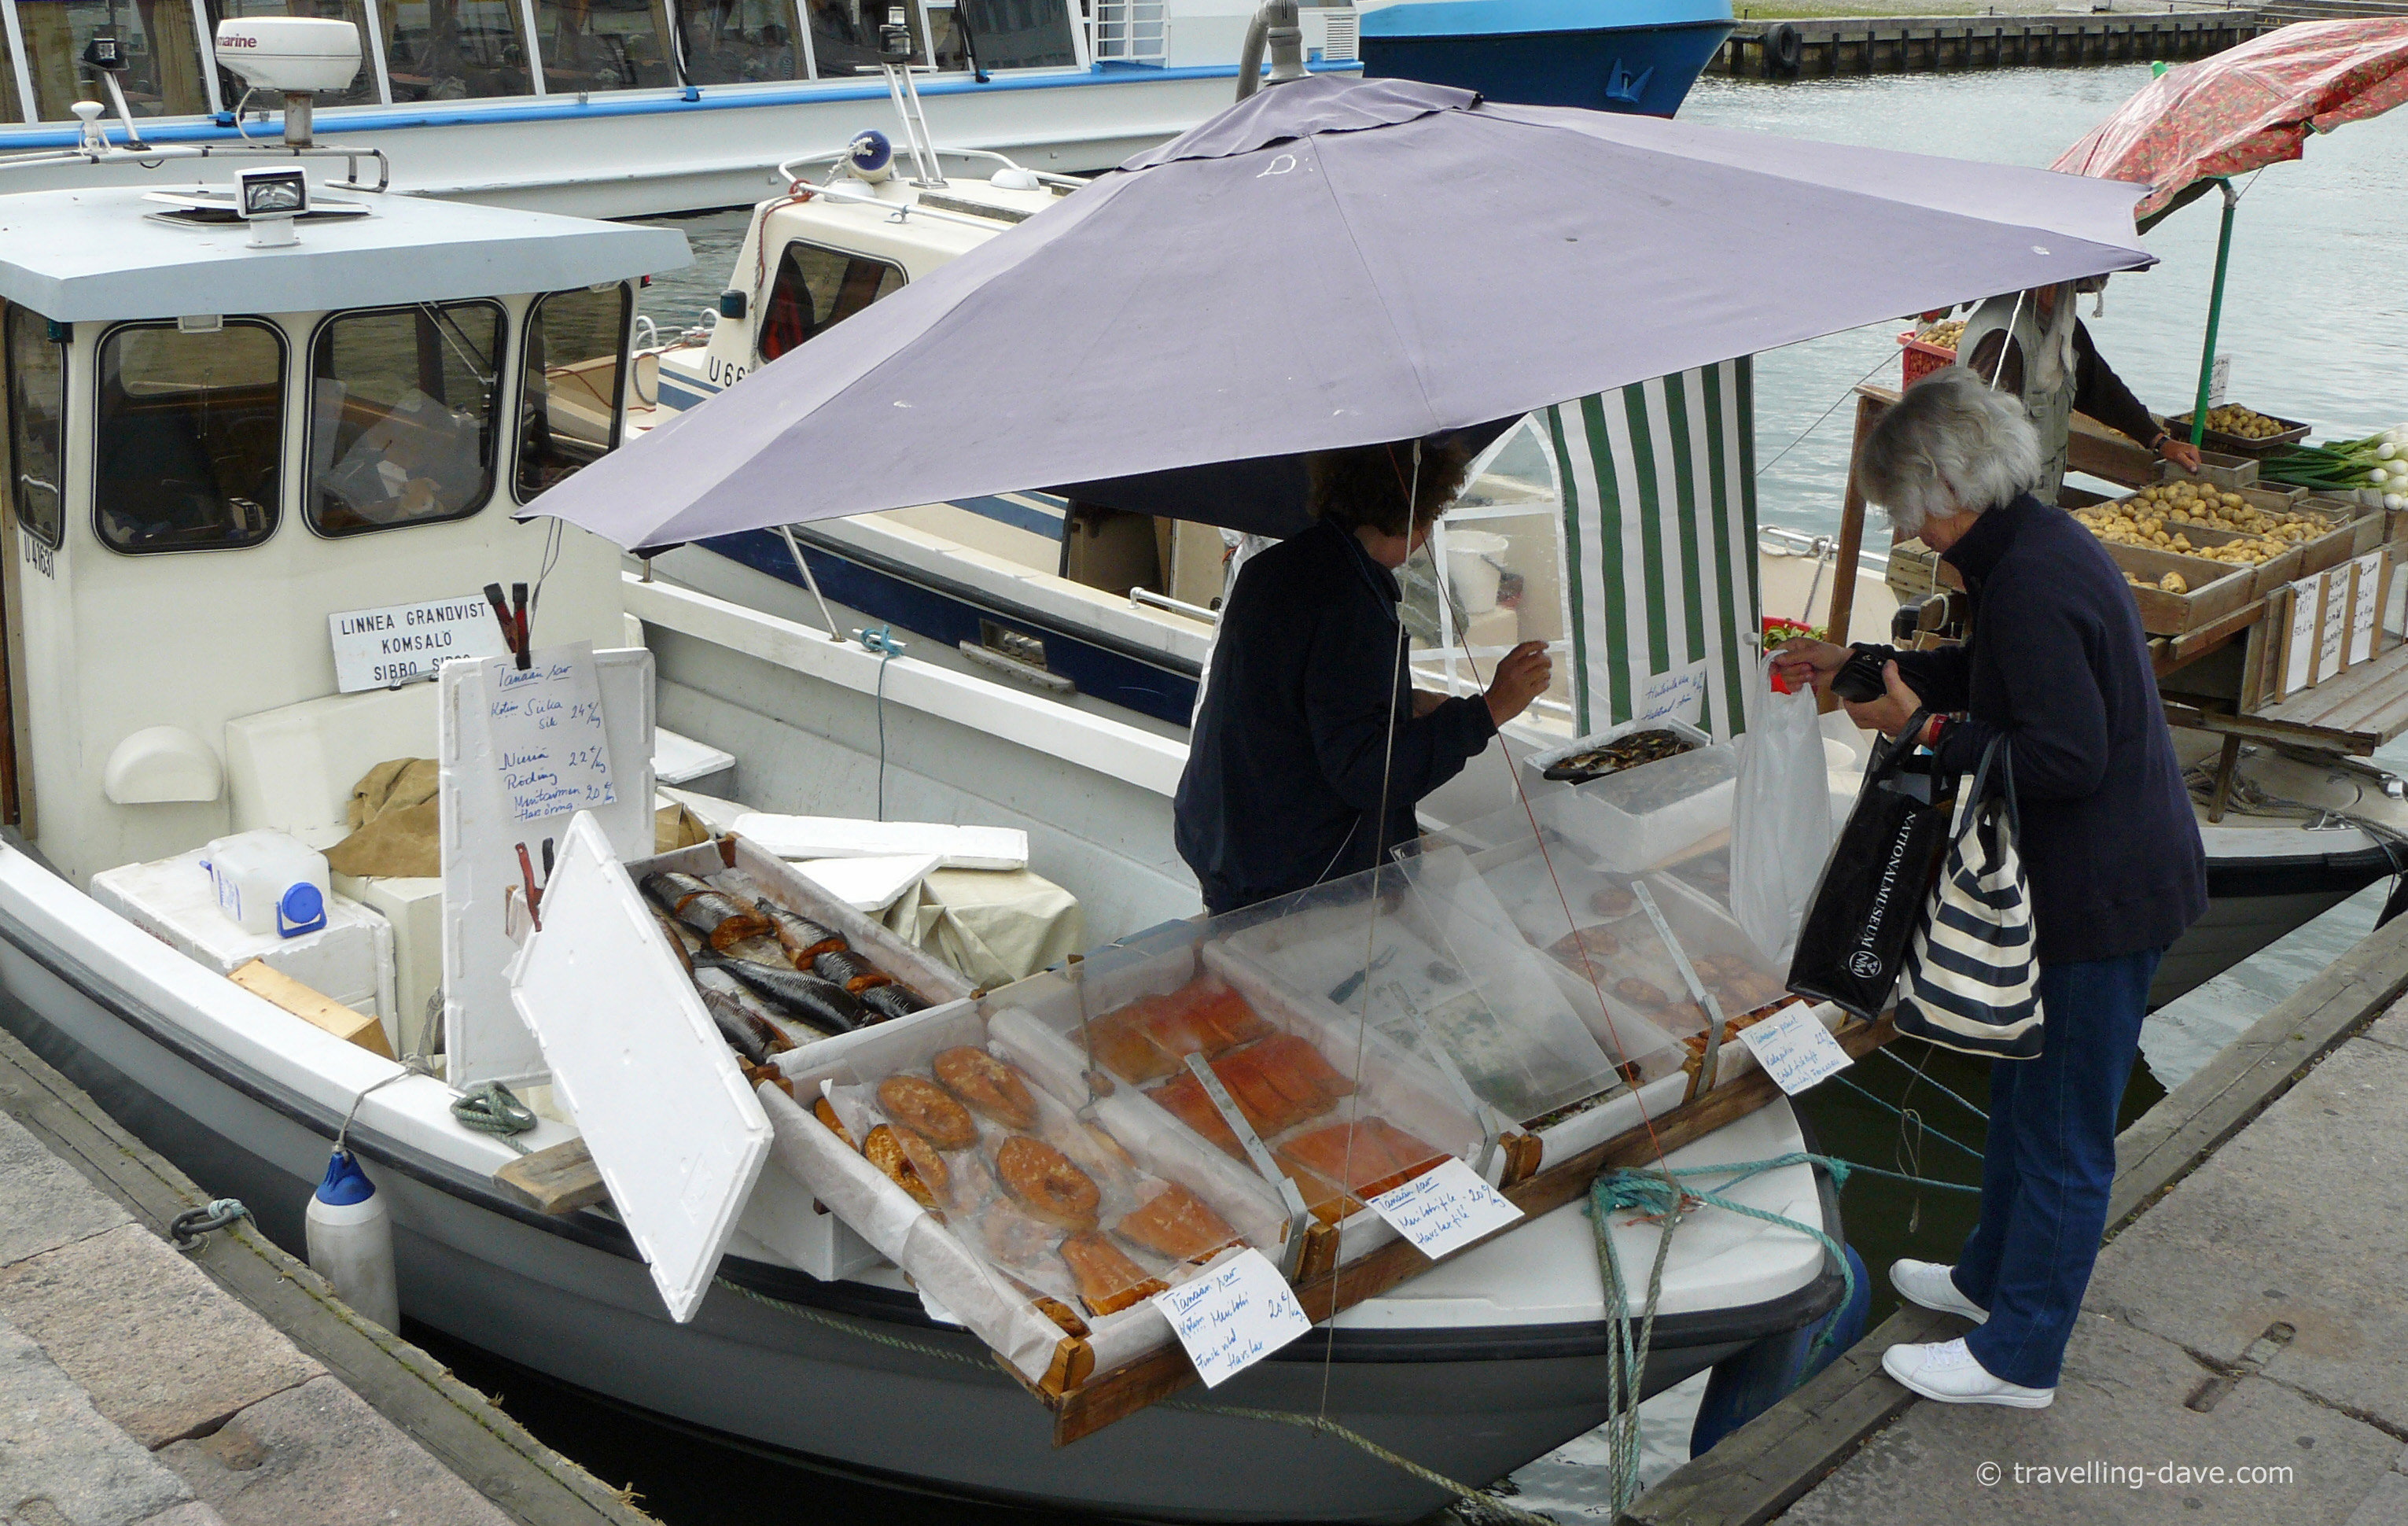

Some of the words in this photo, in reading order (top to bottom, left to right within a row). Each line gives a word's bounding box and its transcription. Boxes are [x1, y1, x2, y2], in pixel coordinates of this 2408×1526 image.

[724, 363, 750, 387] 66
[341, 614, 395, 635] LINNEA
[382, 630, 452, 654] KOMSALÖ
[374, 662, 417, 681] SIBBO
[1861, 810, 1916, 949] NATIONALMUSEUM
